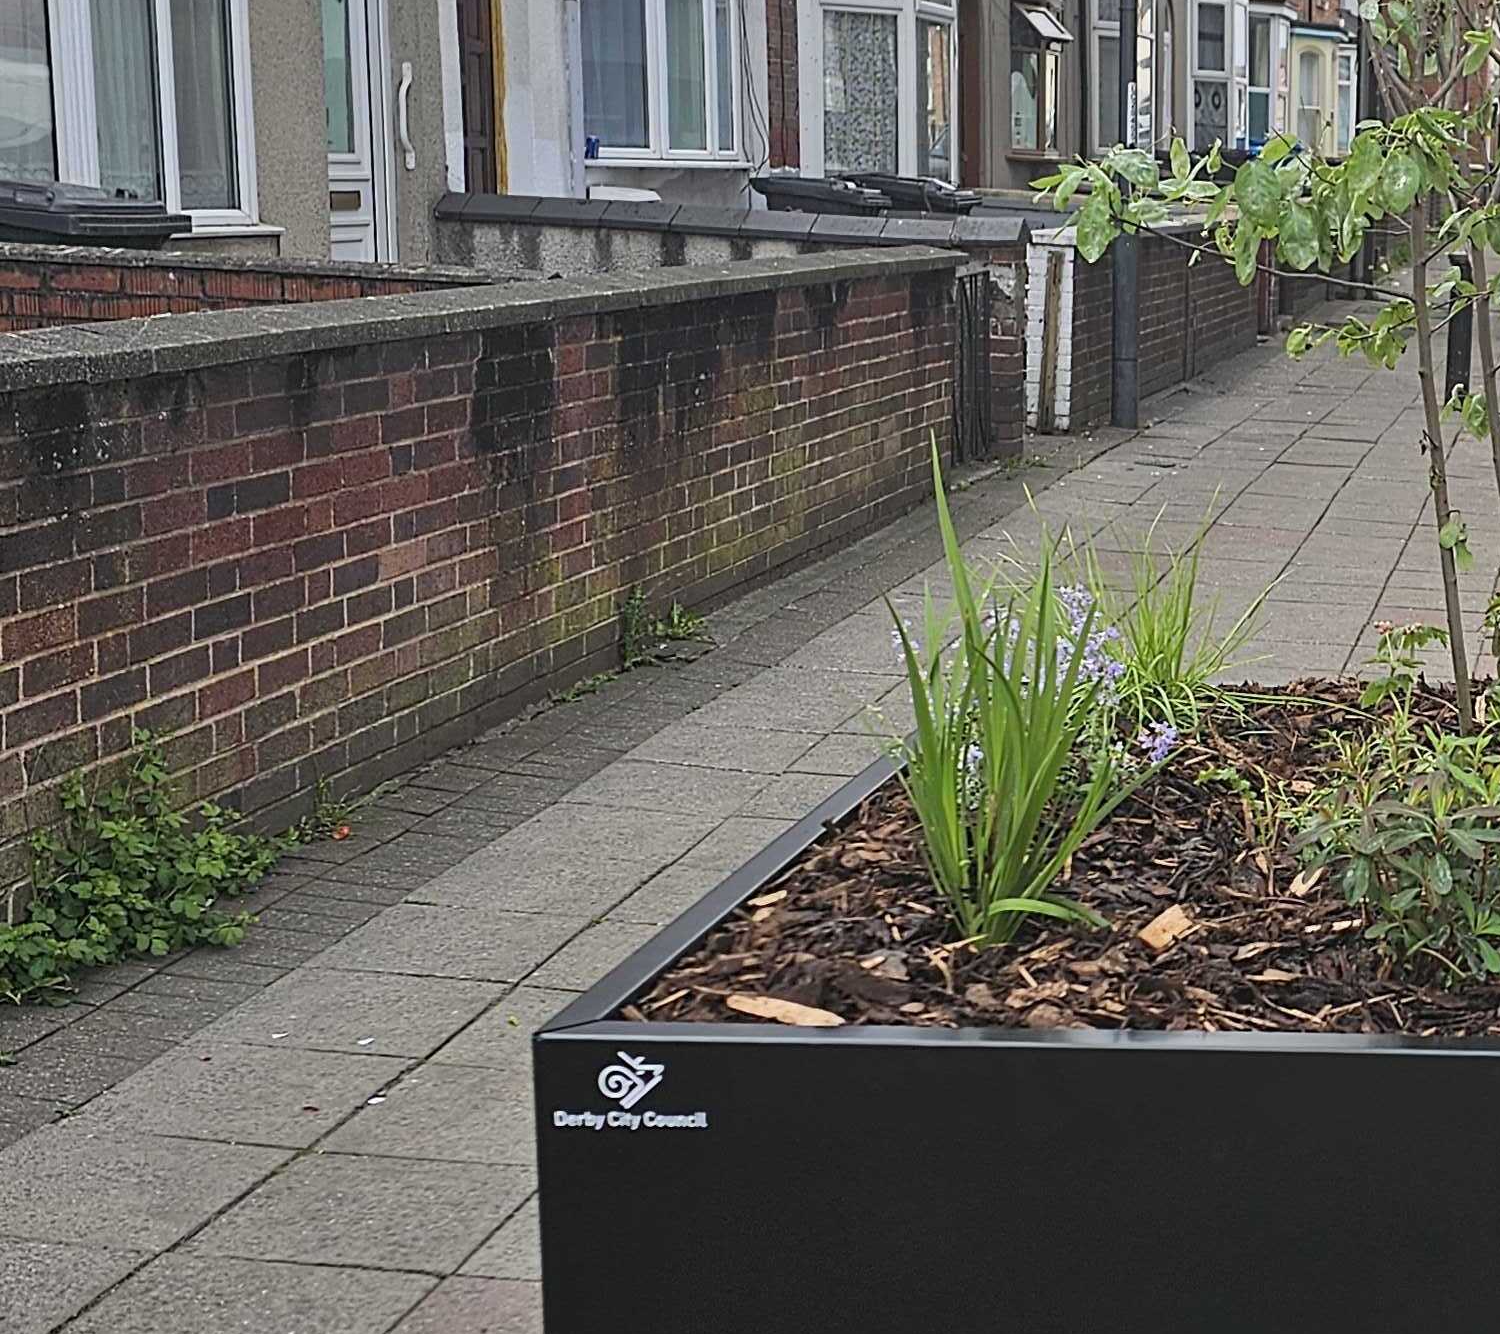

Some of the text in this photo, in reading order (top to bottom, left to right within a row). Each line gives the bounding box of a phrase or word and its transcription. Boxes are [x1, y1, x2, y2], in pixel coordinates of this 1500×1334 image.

[553, 1110, 708, 1131] Derby City Council
